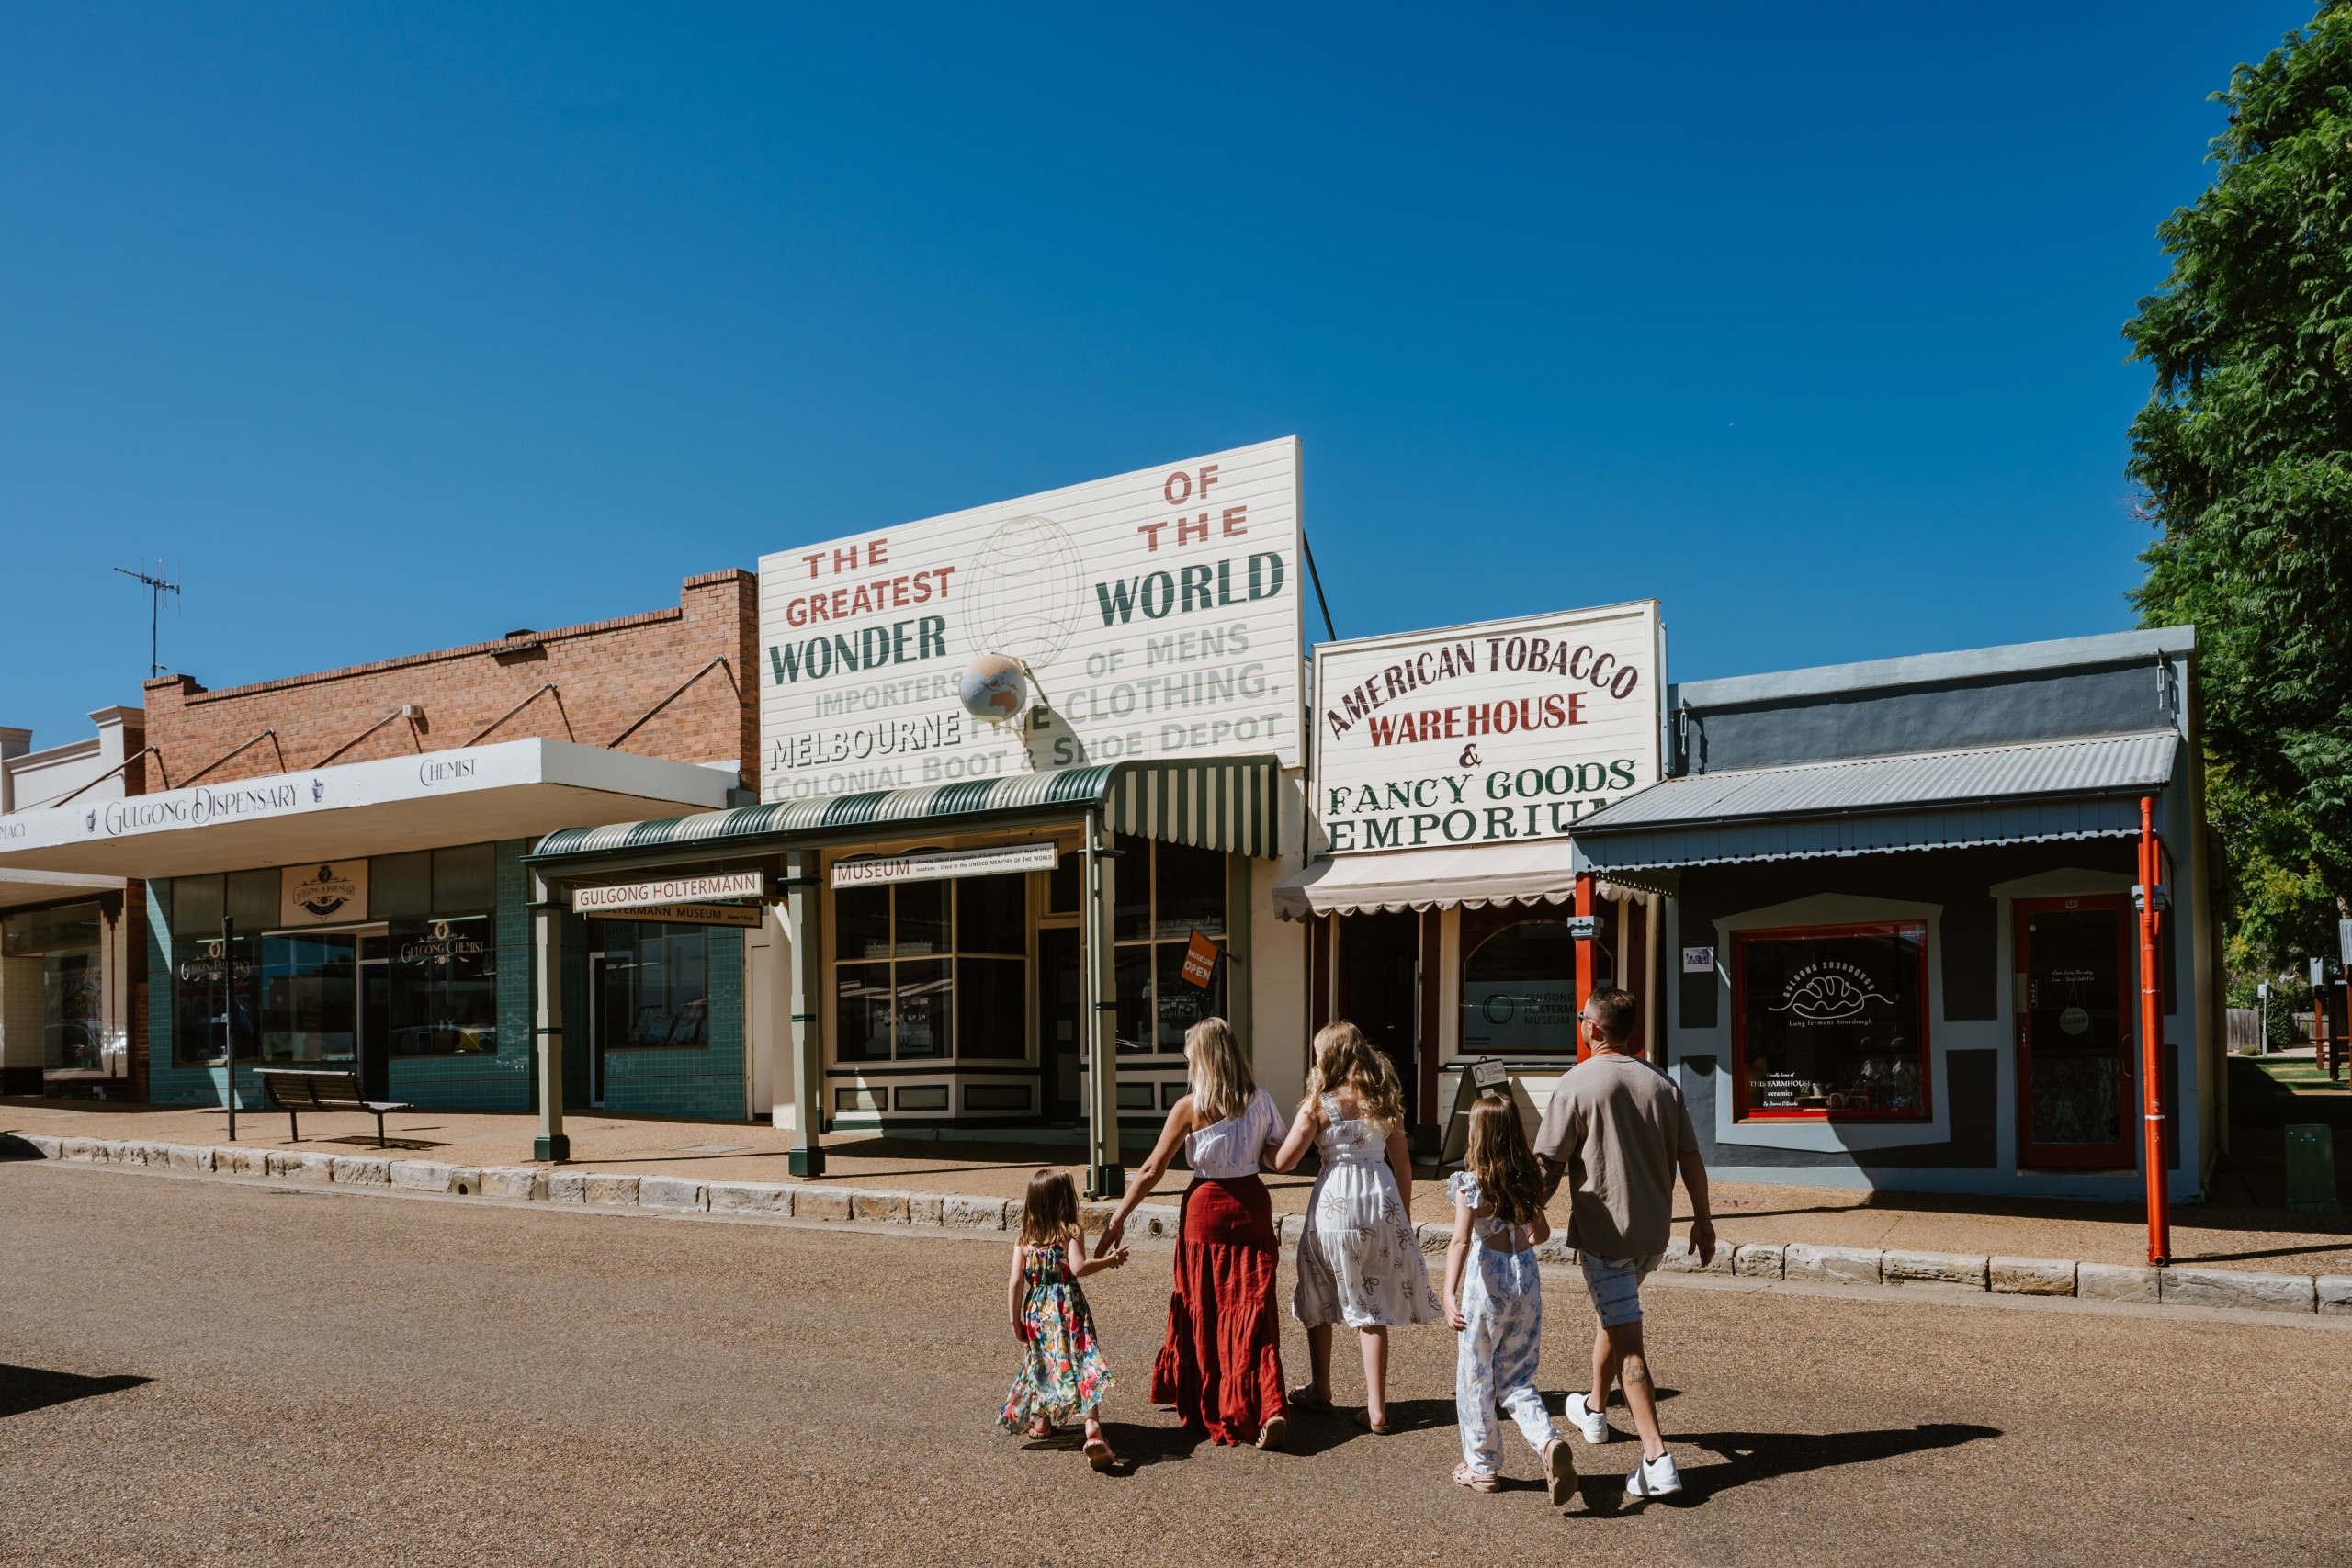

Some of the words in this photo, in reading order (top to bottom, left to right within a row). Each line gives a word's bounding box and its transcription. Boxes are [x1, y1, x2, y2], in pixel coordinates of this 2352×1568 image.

[1164, 464, 1219, 505] OF
[1137, 505, 1248, 553] THE
[802, 538, 888, 580] THE
[786, 566, 956, 627] GREATEST
[1095, 551, 1285, 627] WORLD
[769, 615, 947, 686] WONDER
[1086, 649, 1125, 679] OF
[1148, 623, 1250, 668] MENS
[1326, 640, 1476, 740] AMERICAN
[1486, 637, 1638, 699] TOBACCO
[770, 710, 960, 770] MELBOURNE
[1065, 662, 1280, 725] CLOTHING.
[1368, 692, 1588, 747] WAREHOUSE
[420, 758, 477, 786] CHEMIST
[773, 764, 910, 803] COLONIAL
[922, 750, 1008, 784] BOOT
[1020, 748, 1037, 771] &
[1053, 727, 1143, 766] SHOE
[1160, 712, 1283, 753] DEPOT
[1458, 742, 1483, 768] &
[1327, 773, 1474, 816] FANCY
[1486, 759, 1636, 801] GOODS
[106, 801, 187, 836] GULGONG
[191, 784, 299, 825] DISPENSARY
[1327, 796, 1626, 852] EMPORIU
[838, 859, 910, 881] MUSEUM
[950, 853, 976, 862] photographs
[580, 885, 649, 906] GULGONG
[653, 874, 755, 899] HOLTERMANN
[677, 908, 722, 919] MUSEUM
[401, 943, 445, 963] GULGONG
[447, 940, 484, 955] CHEMIST
[1184, 960, 1211, 981] OPEN
[1188, 949, 1214, 967] MUSEUM
[1525, 993, 1576, 1003] GULGONG
[1783, 964, 1818, 998] GULGONG
[1822, 961, 1875, 991] SOURDOUGH
[1525, 1016, 1570, 1025] MUSEUM
[1836, 1018, 1873, 1027] Sourdough
